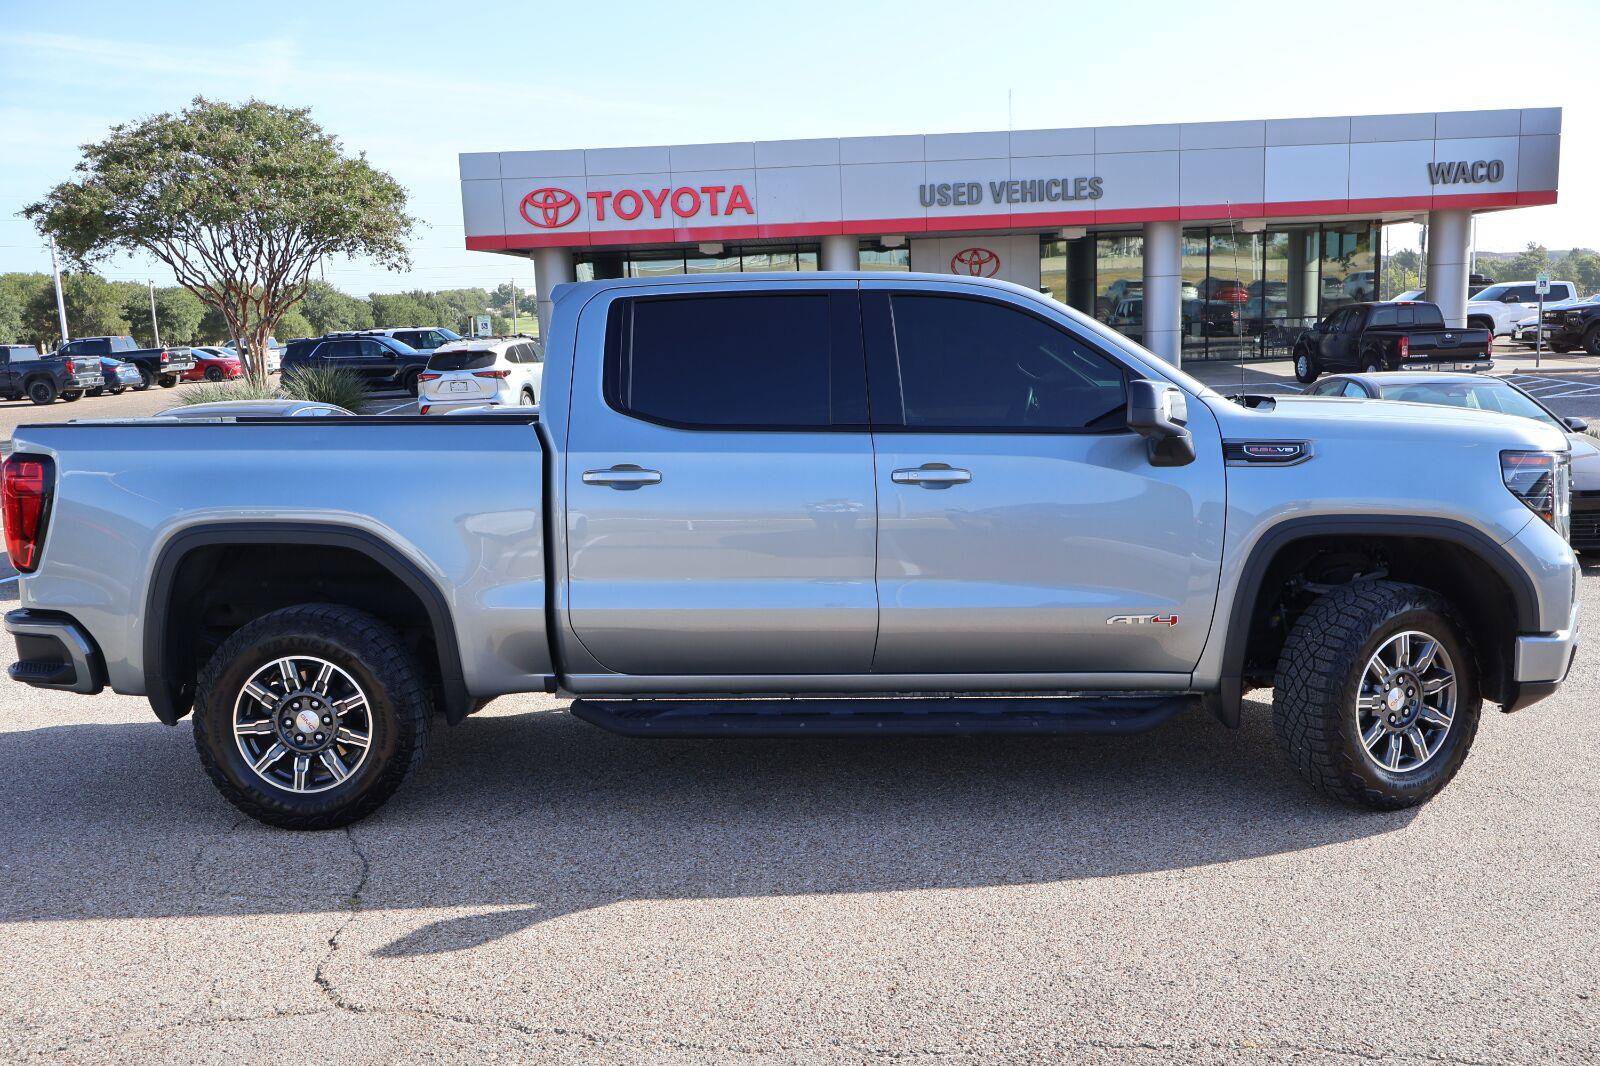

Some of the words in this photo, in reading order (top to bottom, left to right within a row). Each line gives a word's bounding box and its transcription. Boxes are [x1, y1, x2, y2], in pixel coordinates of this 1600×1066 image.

[1427, 160, 1504, 185] WACO
[587, 184, 754, 221] TOYOTA
[919, 182, 983, 207] USED
[989, 176, 1104, 204] VEHICLES
